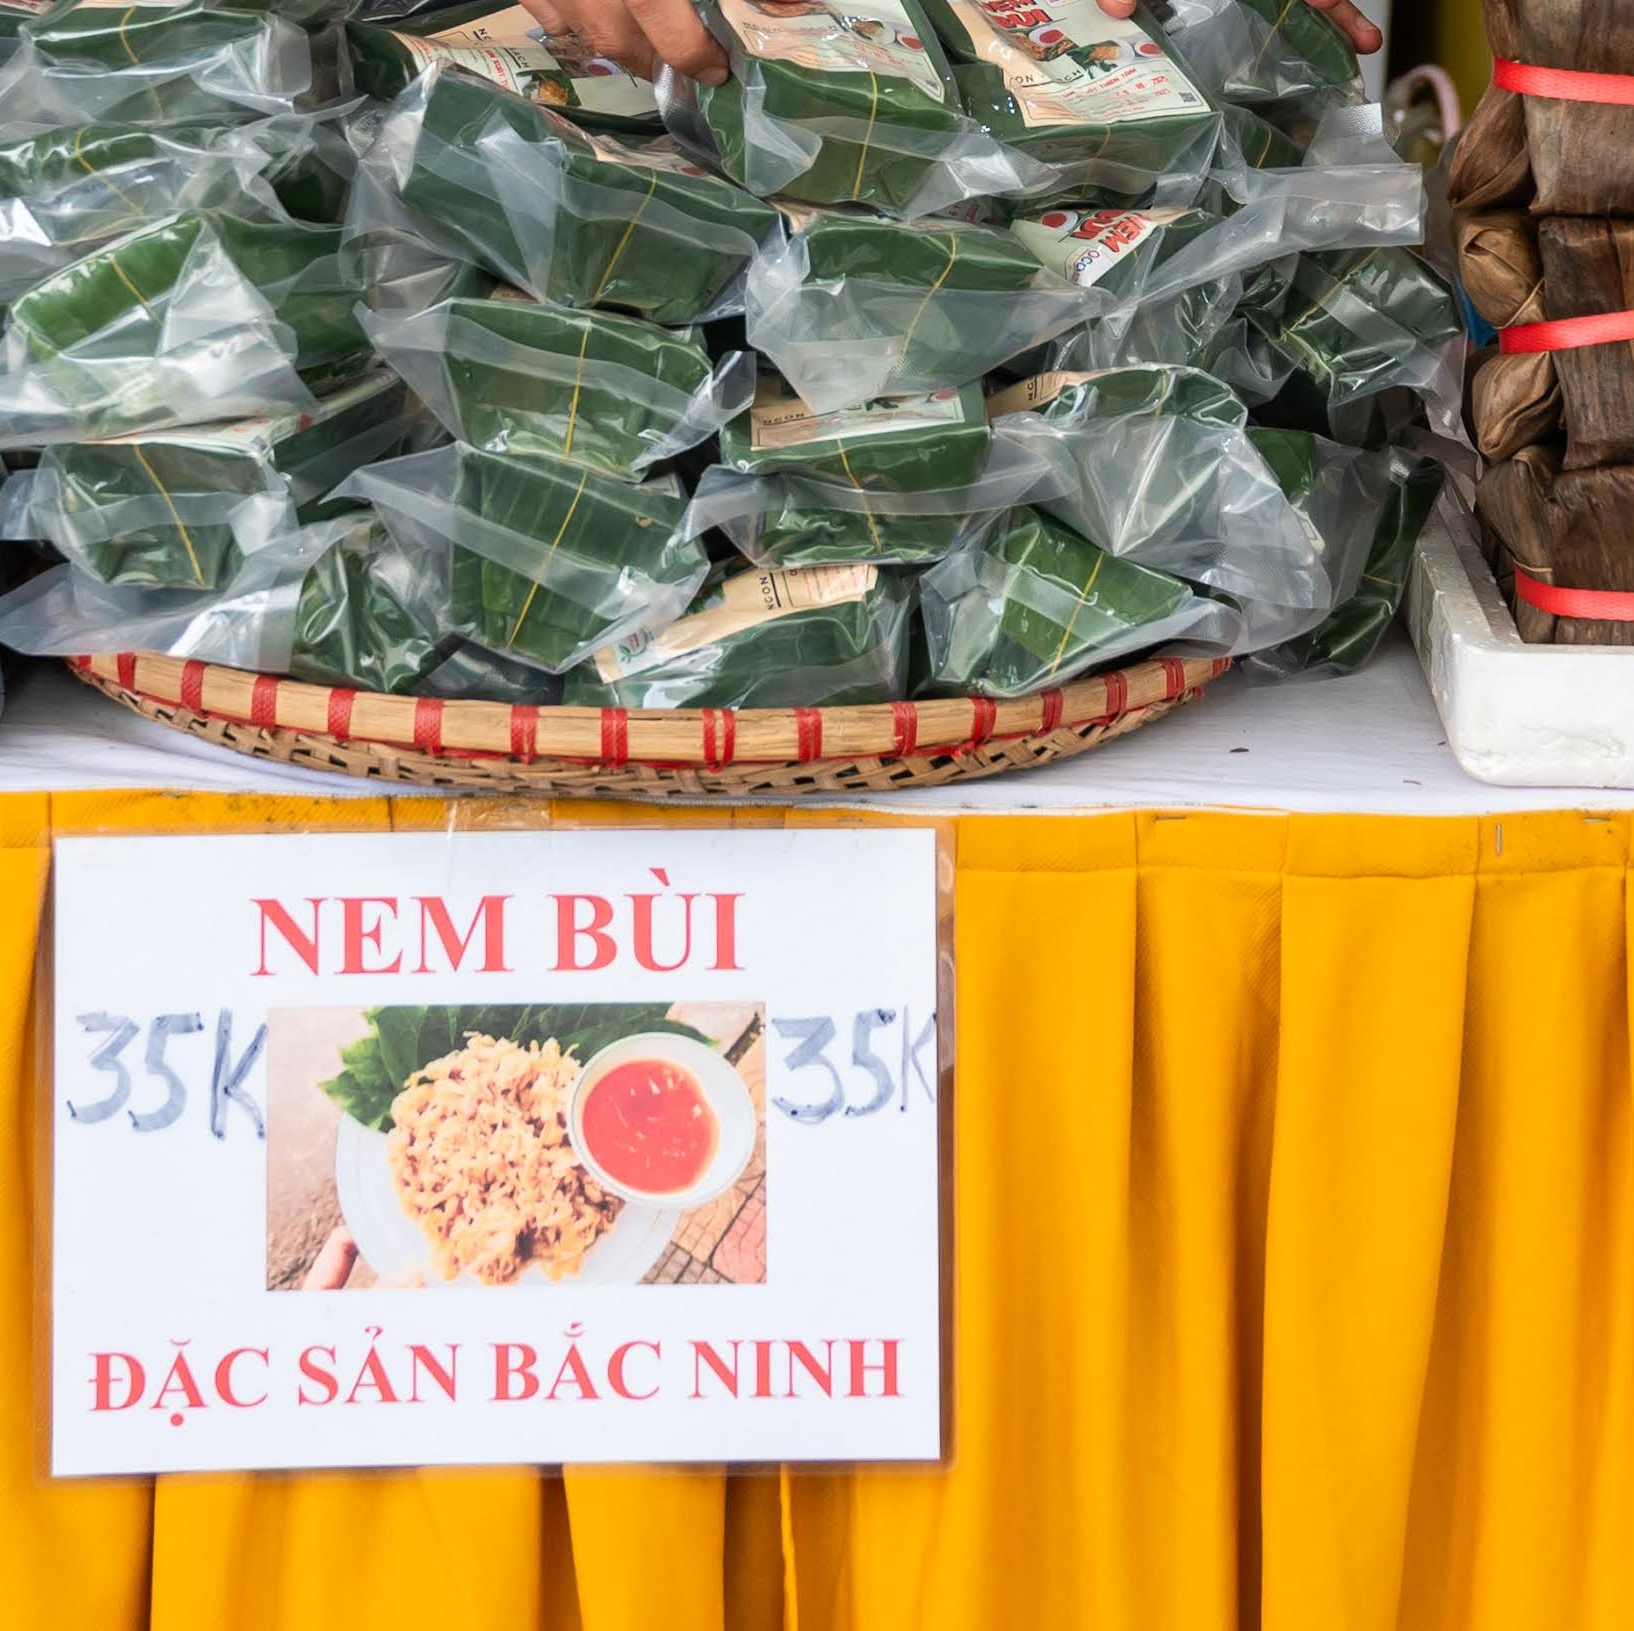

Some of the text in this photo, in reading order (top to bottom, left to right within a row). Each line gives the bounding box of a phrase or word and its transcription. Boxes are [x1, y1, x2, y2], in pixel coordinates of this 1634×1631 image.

[250, 867, 747, 977] NEM BÙI
[65, 1008, 267, 1140] 35K
[770, 1007, 938, 1125] 35K
[87, 1321, 905, 1428] ĐẶC SẢN BẮC NINH
